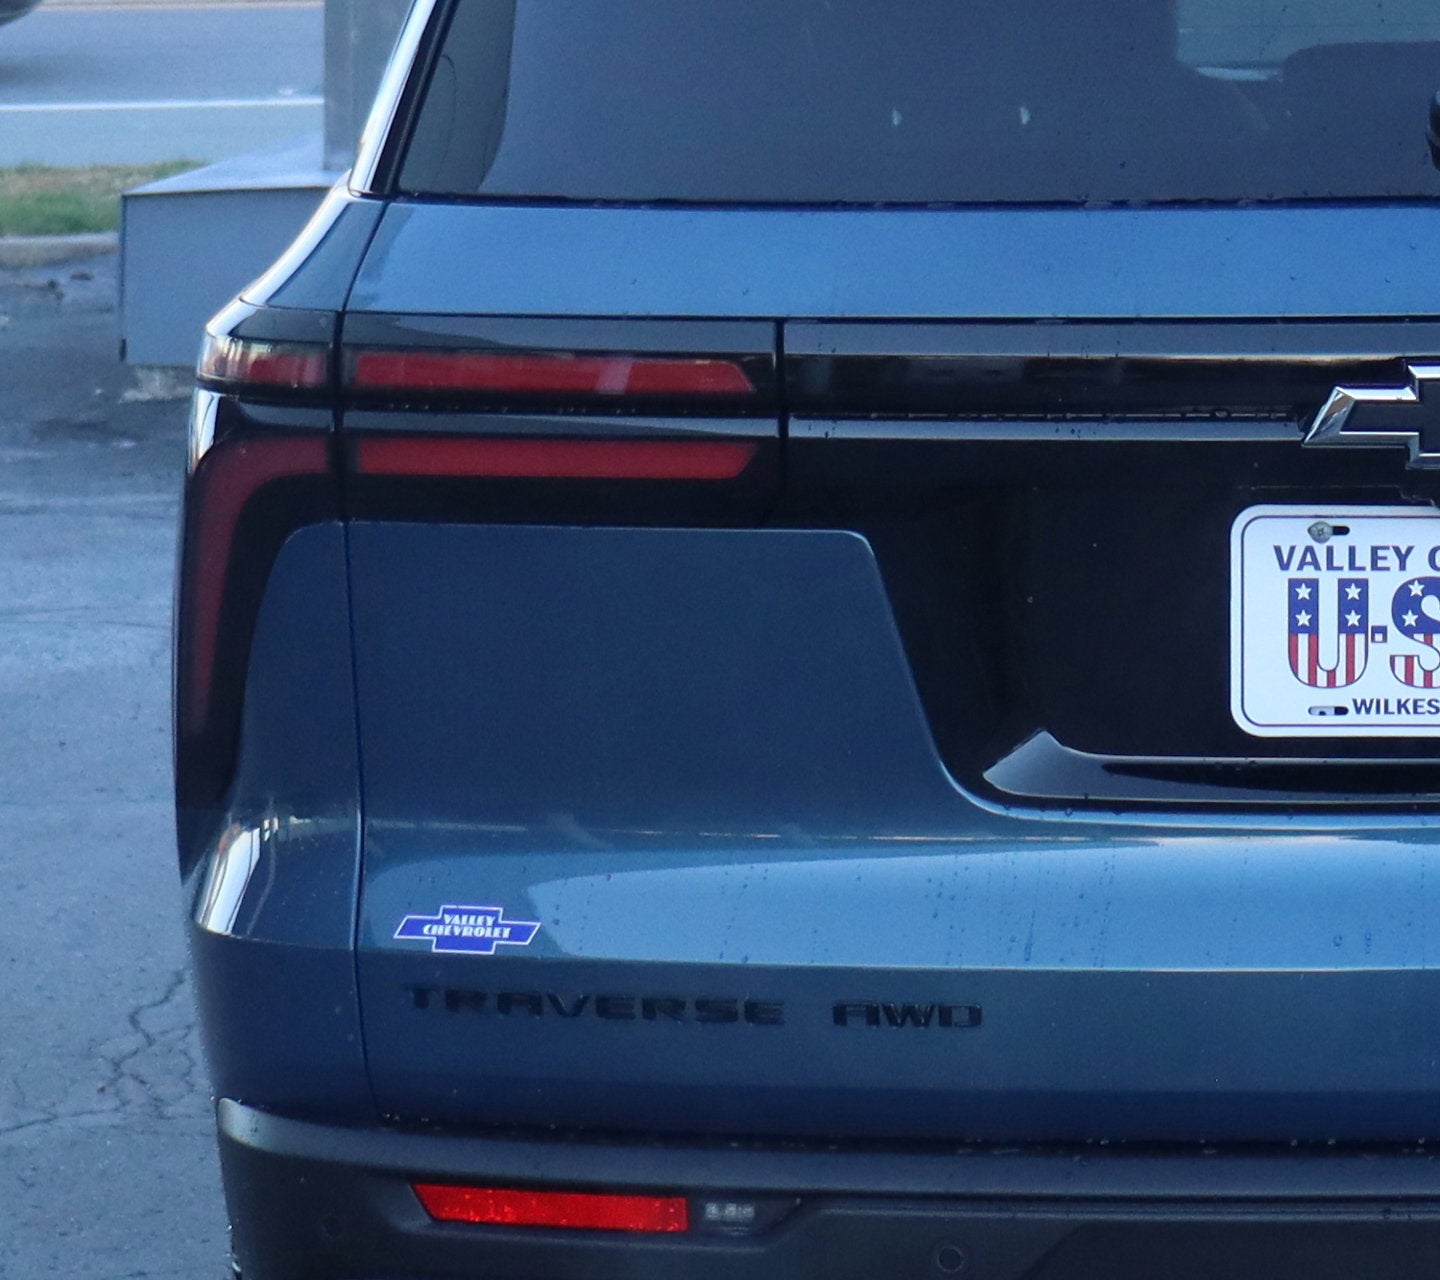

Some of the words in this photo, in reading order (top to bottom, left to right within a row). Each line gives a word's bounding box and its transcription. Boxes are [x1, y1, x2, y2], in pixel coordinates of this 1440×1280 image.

[1273, 545, 1415, 571] VALLEY
[444, 914, 496, 926] VALLEY
[422, 924, 512, 938] CHEVROLET
[408, 985, 785, 1025] TRAVERSE
[832, 1001, 983, 1028] AWD
